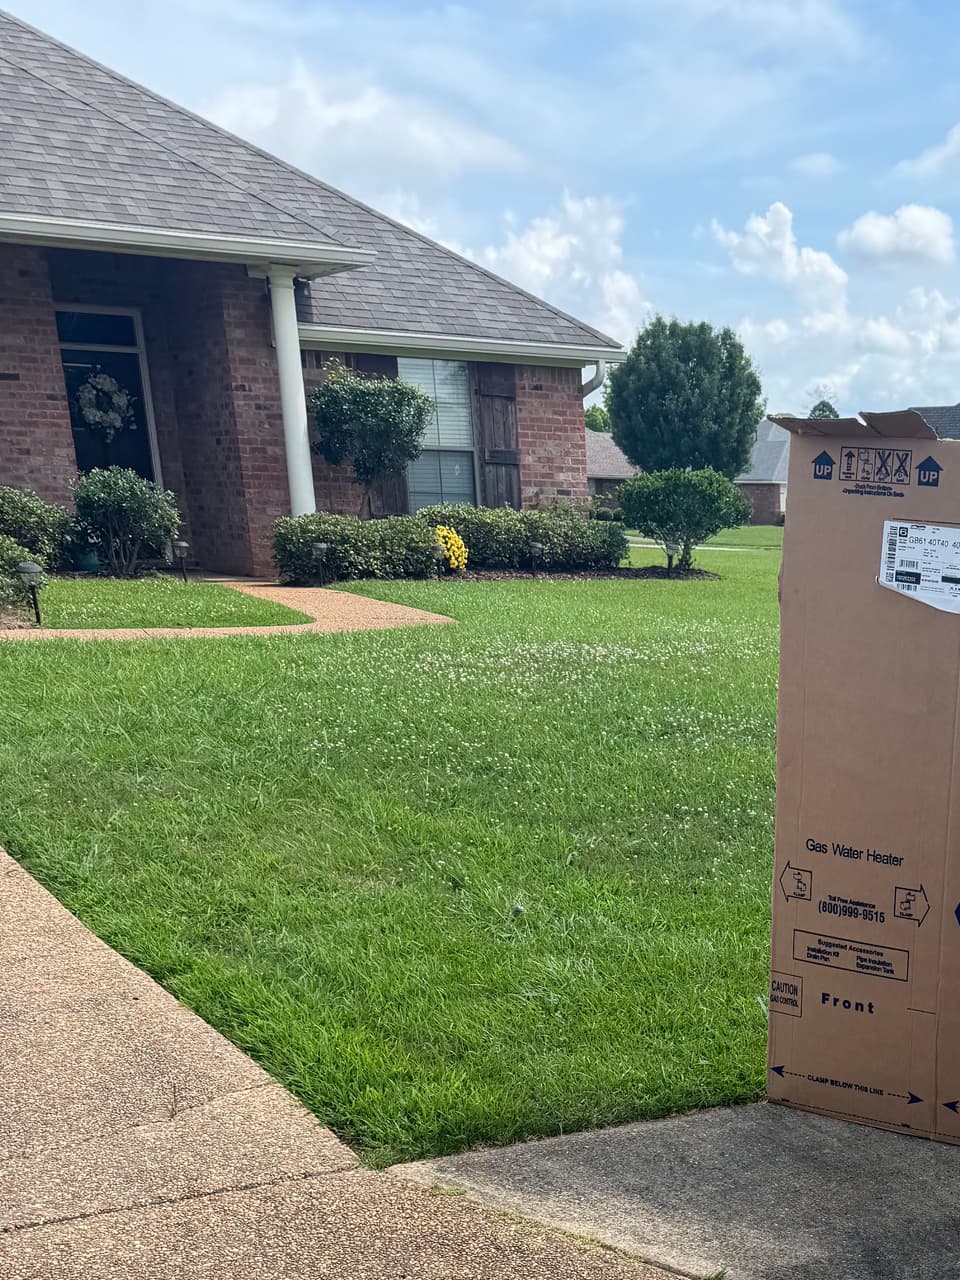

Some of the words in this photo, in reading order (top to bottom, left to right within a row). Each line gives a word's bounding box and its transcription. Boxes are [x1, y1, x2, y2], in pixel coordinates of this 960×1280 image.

[816, 464, 831, 476] UP
[920, 471, 938, 483] UP
[806, 838, 828, 854] Gas
[832, 842, 863, 860] Water
[866, 849, 904, 867] Heater
[818, 900, 885, 923] (800)999-9515
[848, 899, 876, 909] Assistance
[817, 938, 848, 952] Suggested
[848, 945, 884, 957] Accessories
[856, 955, 867, 964] Pipe
[868, 958, 893, 968] Insulation
[856, 962, 882, 973] Expansion
[882, 966, 895, 975] Tank
[771, 980, 798, 996] CAUTION
[769, 994, 779, 1004] GAS
[779, 996, 799, 1008] CONTROL
[821, 992, 875, 1014] Front
[807, 1074, 829, 1086] CLAMP
[830, 1079, 853, 1090] BELOW
[854, 1084, 868, 1093] THIS
[869, 1087, 884, 1096] LINE
